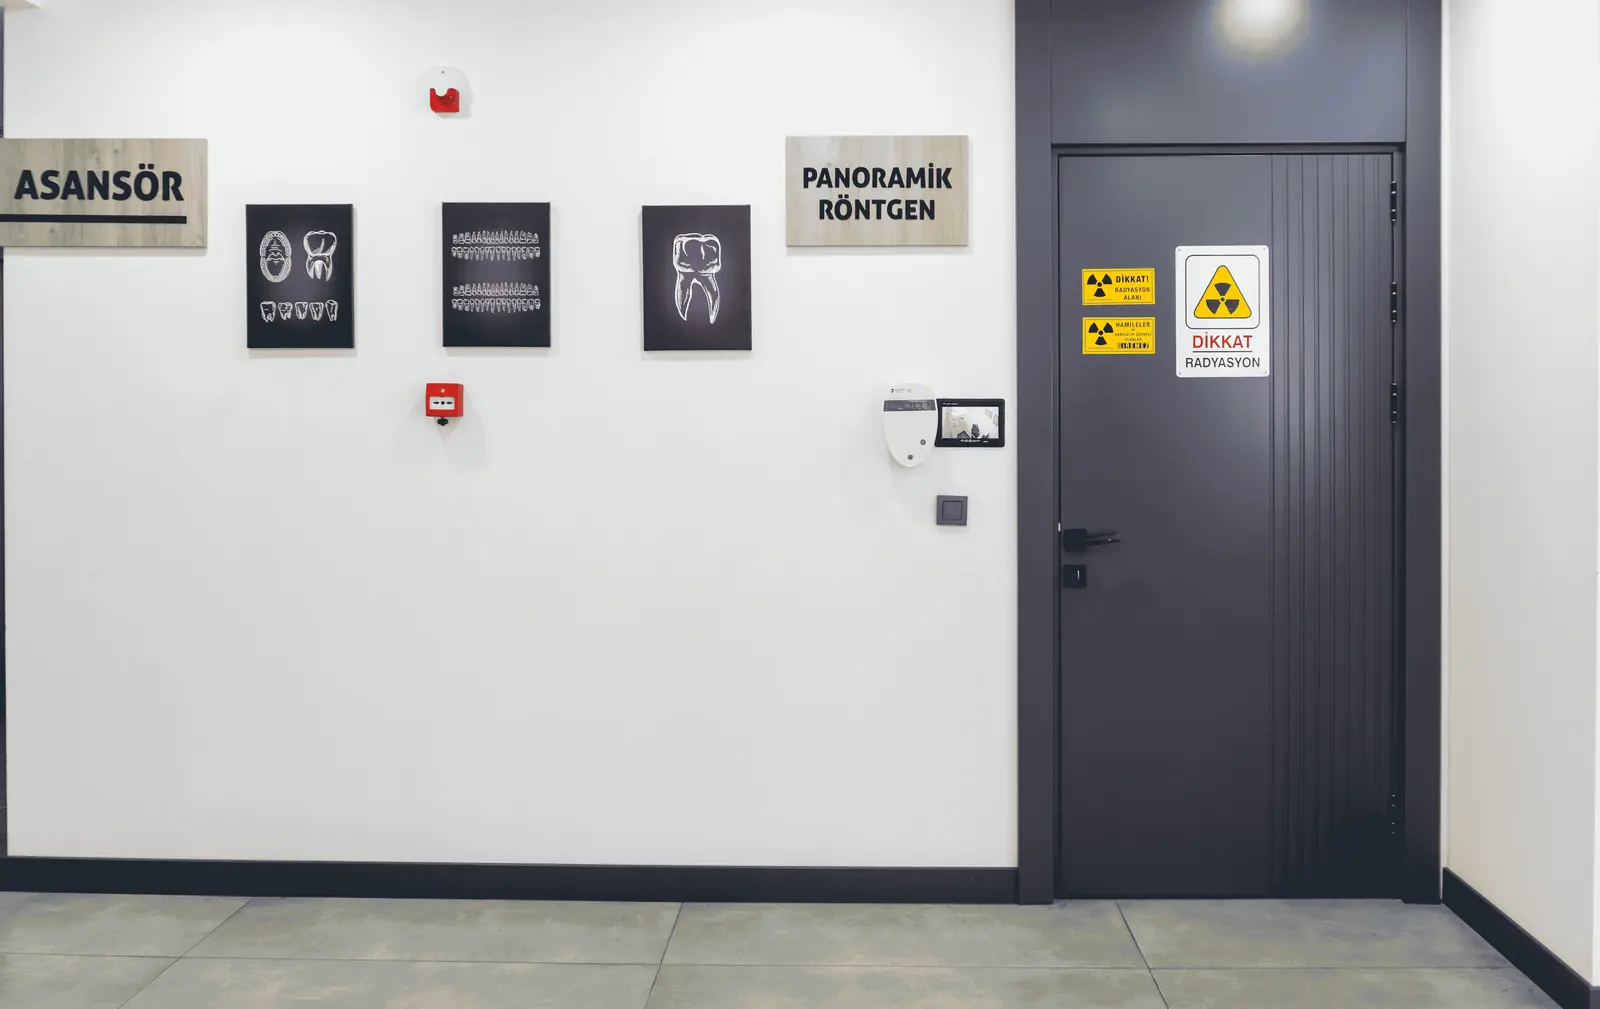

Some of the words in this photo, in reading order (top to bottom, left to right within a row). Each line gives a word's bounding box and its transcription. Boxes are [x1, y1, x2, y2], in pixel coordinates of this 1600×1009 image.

[14, 163, 184, 201] ASANSÖR
[803, 163, 952, 189] PANORAMİK
[819, 194, 935, 220] RÖNTGEN
[1116, 274, 1149, 283] DİKKAT!
[1192, 332, 1253, 348] DİKKAT
[1185, 357, 1260, 368] RADYASYON
